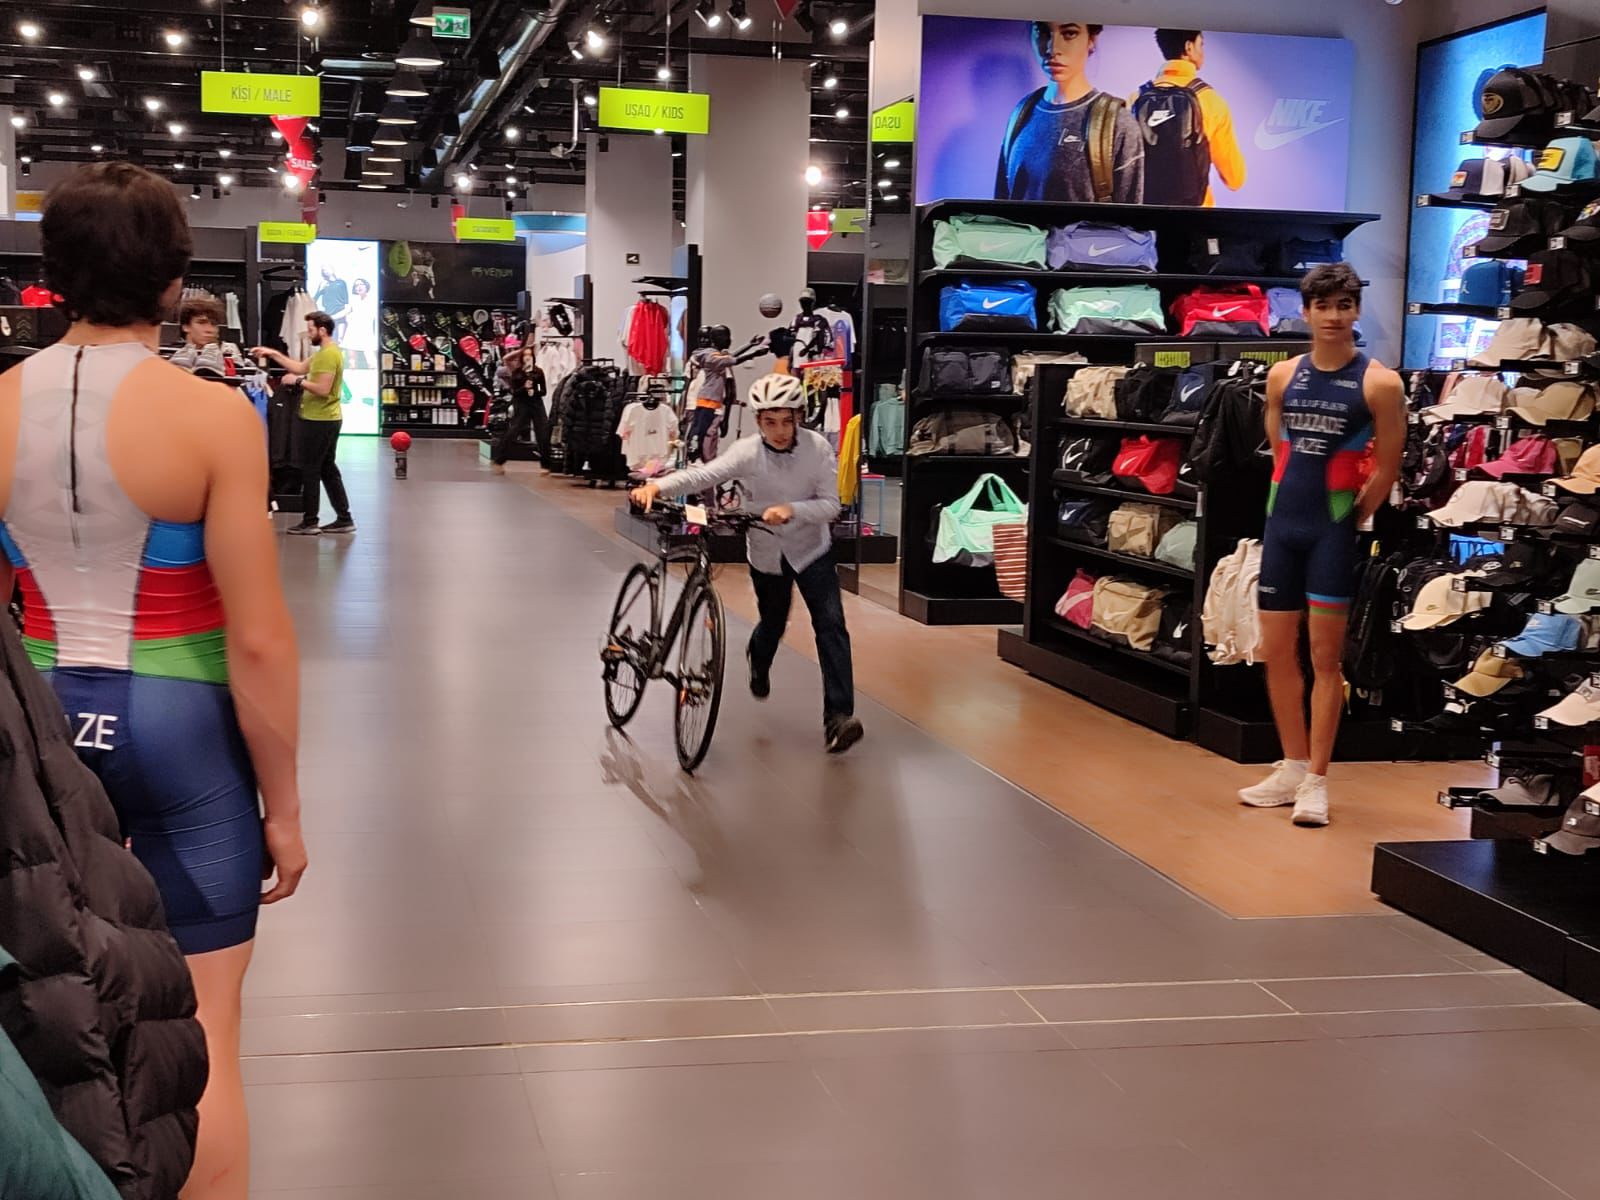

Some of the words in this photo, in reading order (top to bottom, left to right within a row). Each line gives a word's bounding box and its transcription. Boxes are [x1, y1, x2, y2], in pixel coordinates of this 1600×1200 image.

[263, 88, 293, 103] MALE
[661, 105, 685, 120] KIDS
[1266, 98, 1329, 128] NIKE
[290, 158, 313, 171] SALE
[64, 712, 118, 751] ZE
